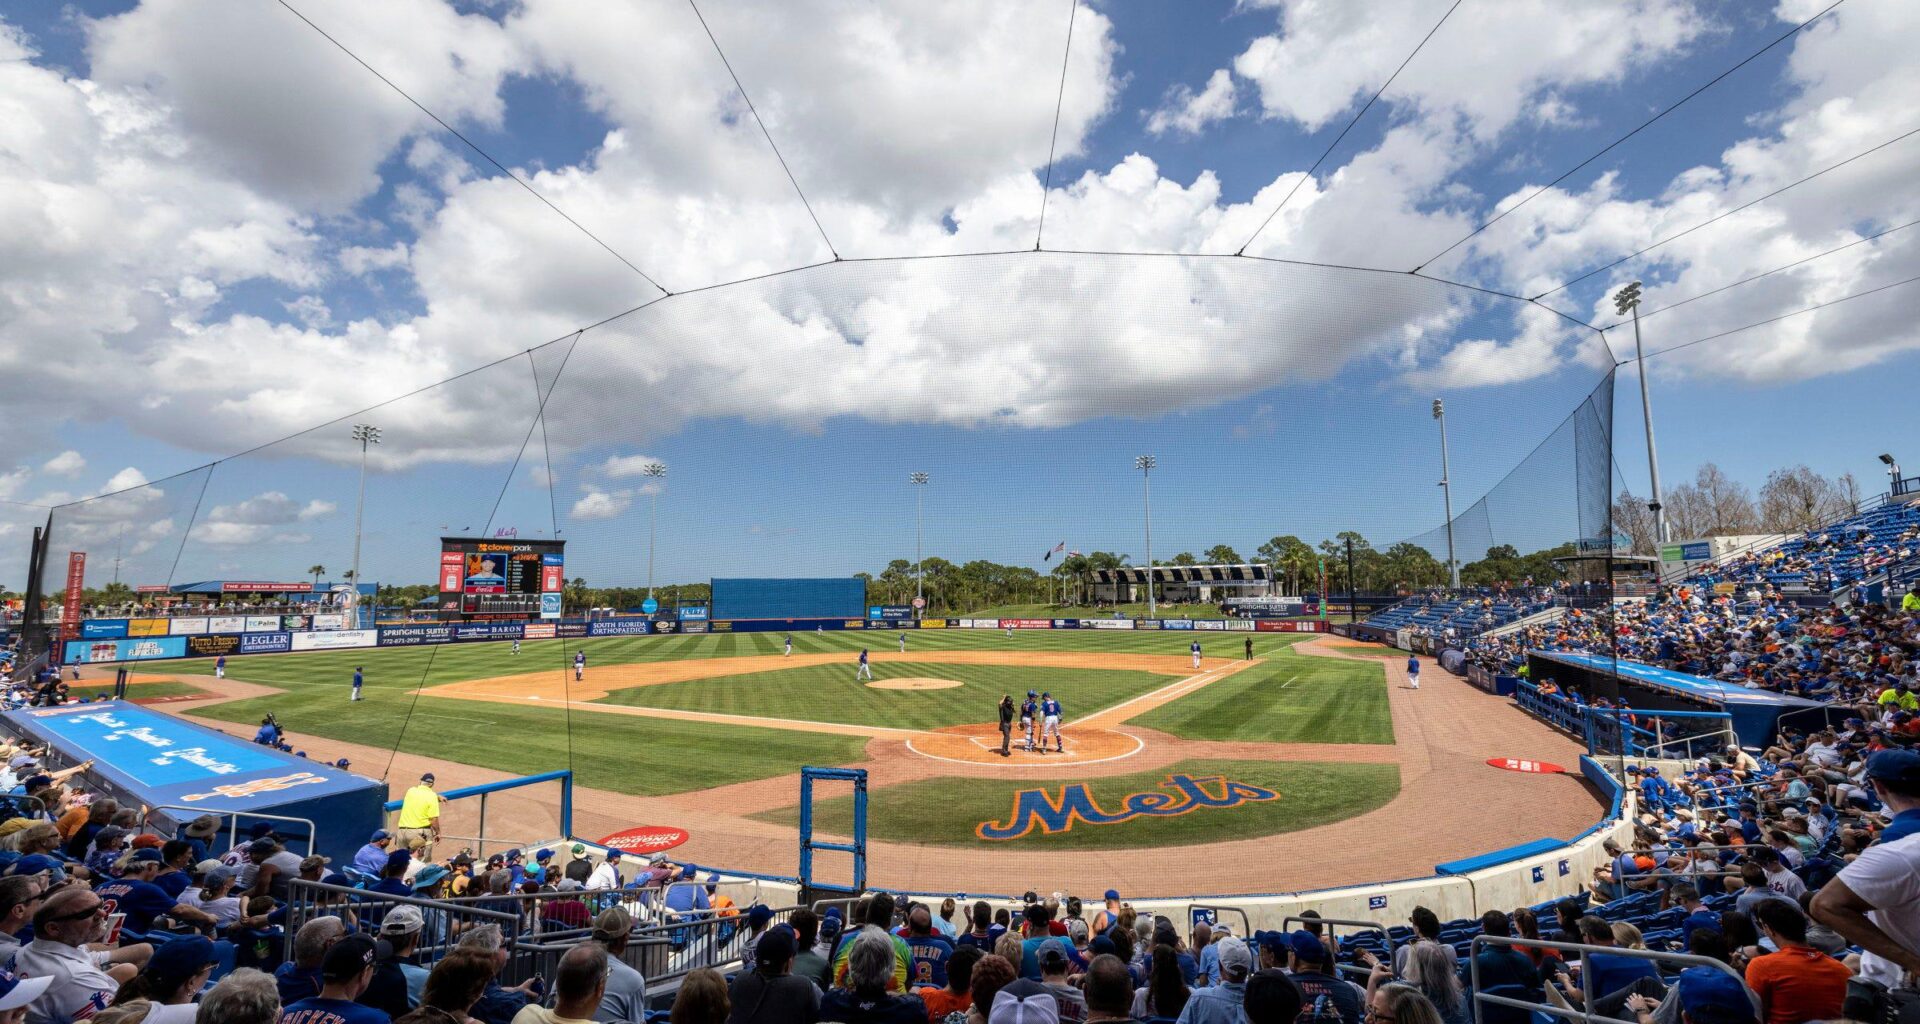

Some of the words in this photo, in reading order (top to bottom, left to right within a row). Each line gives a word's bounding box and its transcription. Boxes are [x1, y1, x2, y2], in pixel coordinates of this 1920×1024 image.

[495, 527, 517, 537] Mets
[488, 544, 532, 552] cloverpark
[382, 629, 425, 637] SPRINGHILL
[593, 627, 646, 635] ORTHOPAEDICS
[244, 635, 287, 646] LEGLER
[976, 773, 1280, 840] Mets
[362, 949, 373, 962] NYC
